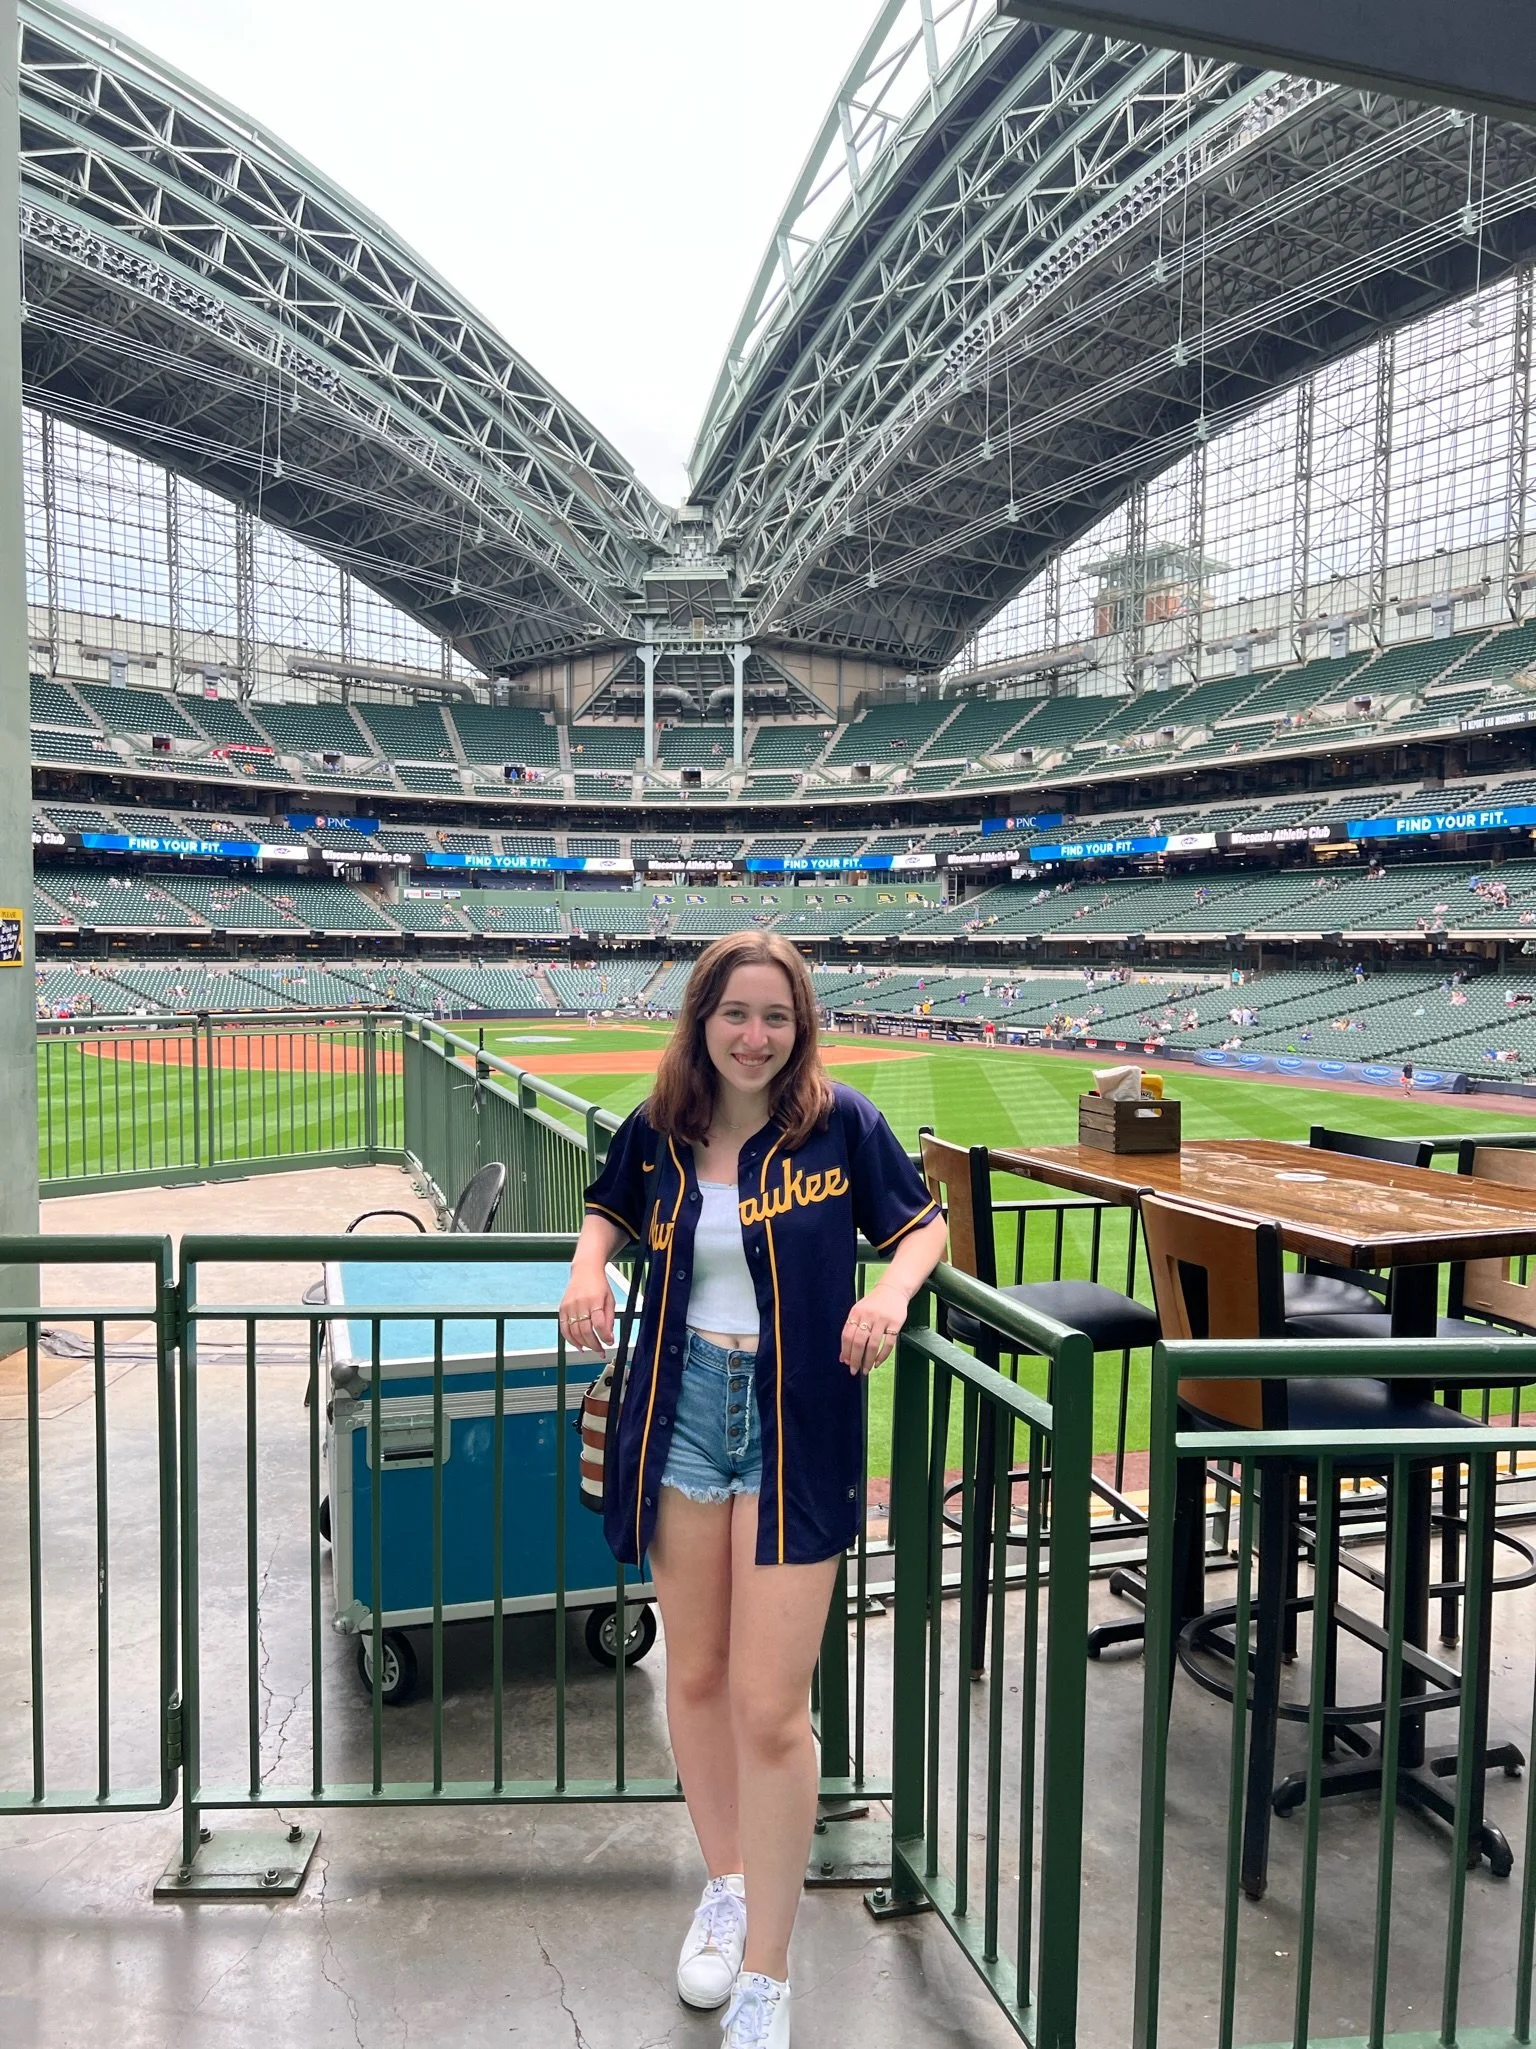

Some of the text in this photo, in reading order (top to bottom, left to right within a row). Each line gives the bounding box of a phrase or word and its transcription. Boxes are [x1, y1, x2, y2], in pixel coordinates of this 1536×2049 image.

[327, 817, 351, 828] PNC
[1016, 816, 1037, 828] PNC
[1396, 811, 1508, 832] FIND YOUR FIT.
[43, 832, 66, 845] Club
[1231, 826, 1331, 844] Wisconsin Athletic Club
[128, 838, 224, 854] FIND YOUR FIT.
[1061, 840, 1135, 857] FIND YOUR FIT.
[321, 849, 412, 864] Wisconsin Athletic Club
[465, 855, 551, 868] FIND YOUR FIT.
[783, 857, 863, 869] FIND YOUR FIT.
[947, 849, 1020, 864] Wisconsin Athletic Club
[648, 860, 733, 870] Wisconsin Athletic Club
